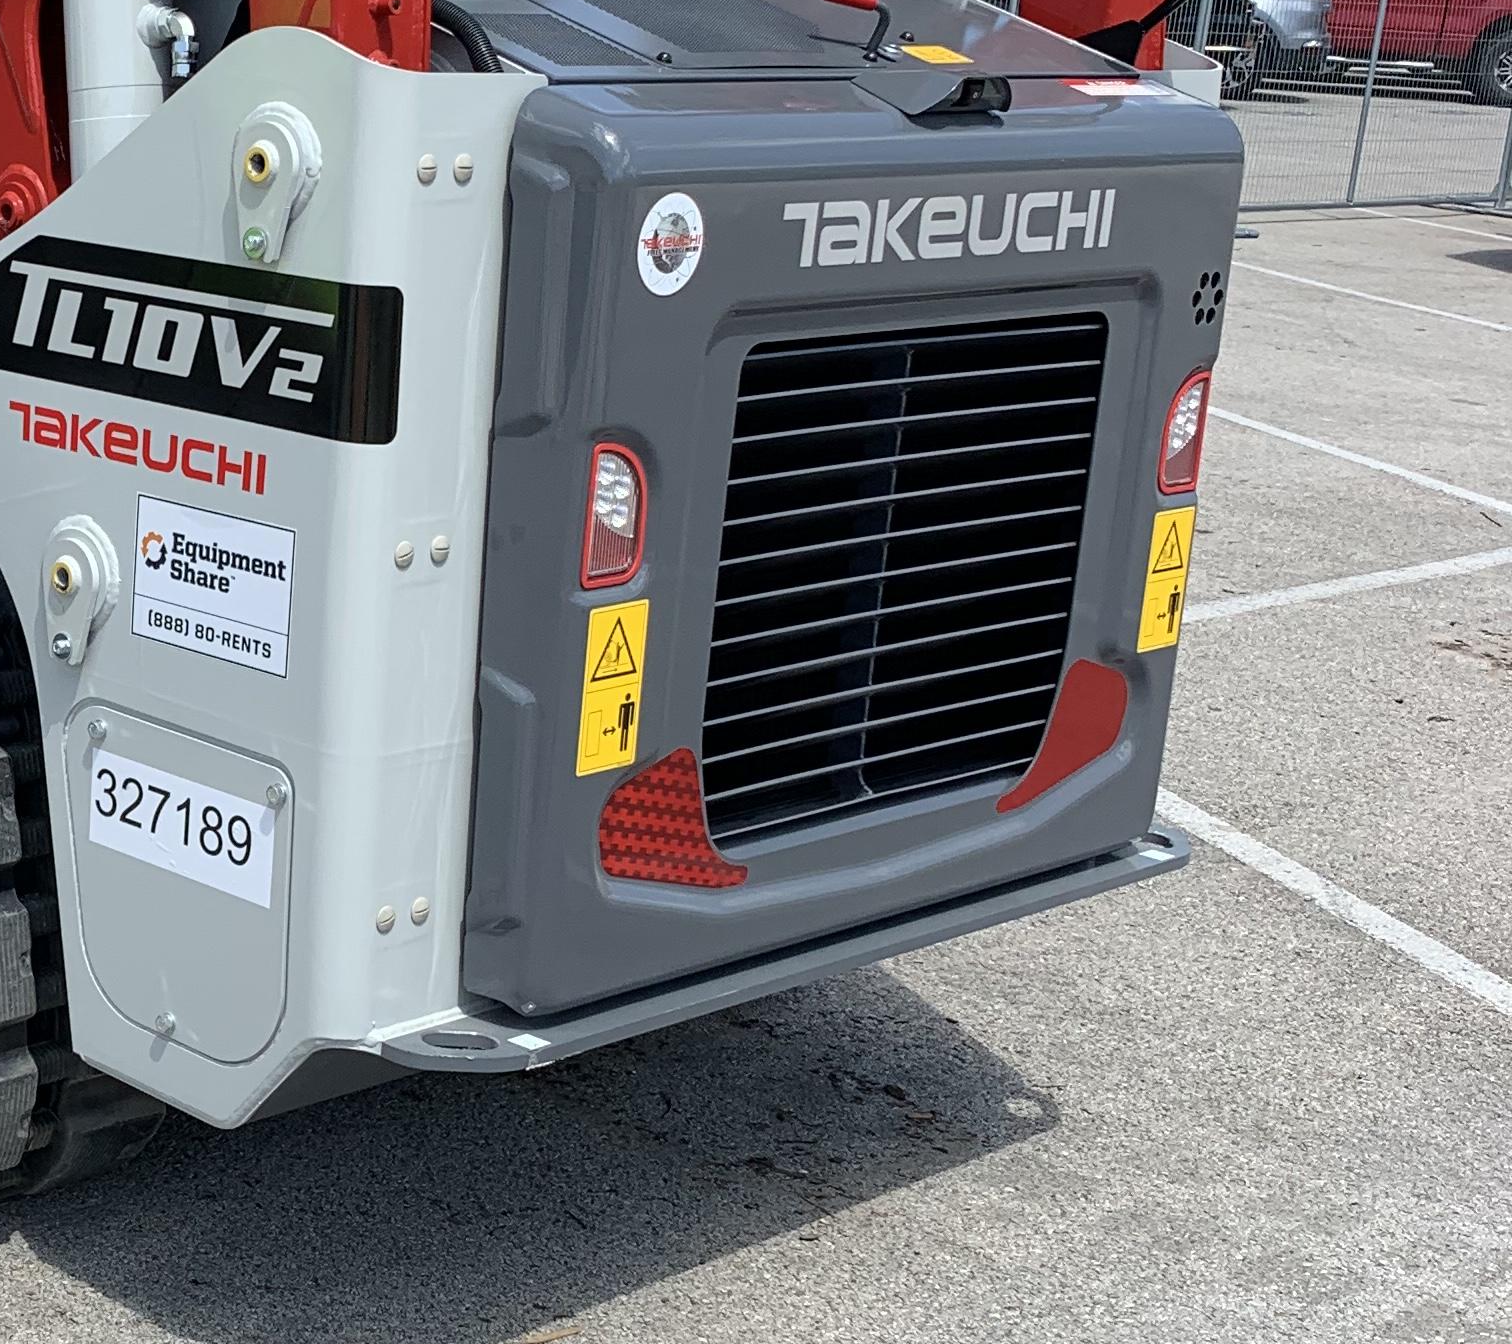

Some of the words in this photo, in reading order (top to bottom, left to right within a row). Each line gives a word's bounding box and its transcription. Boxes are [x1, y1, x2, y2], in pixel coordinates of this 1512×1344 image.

[9, 259, 336, 403] TL10V2
[171, 532, 287, 582] Equipment
[148, 608, 190, 637] (888)
[194, 623, 272, 659] 80-RENTS
[94, 767, 253, 867] 327189
